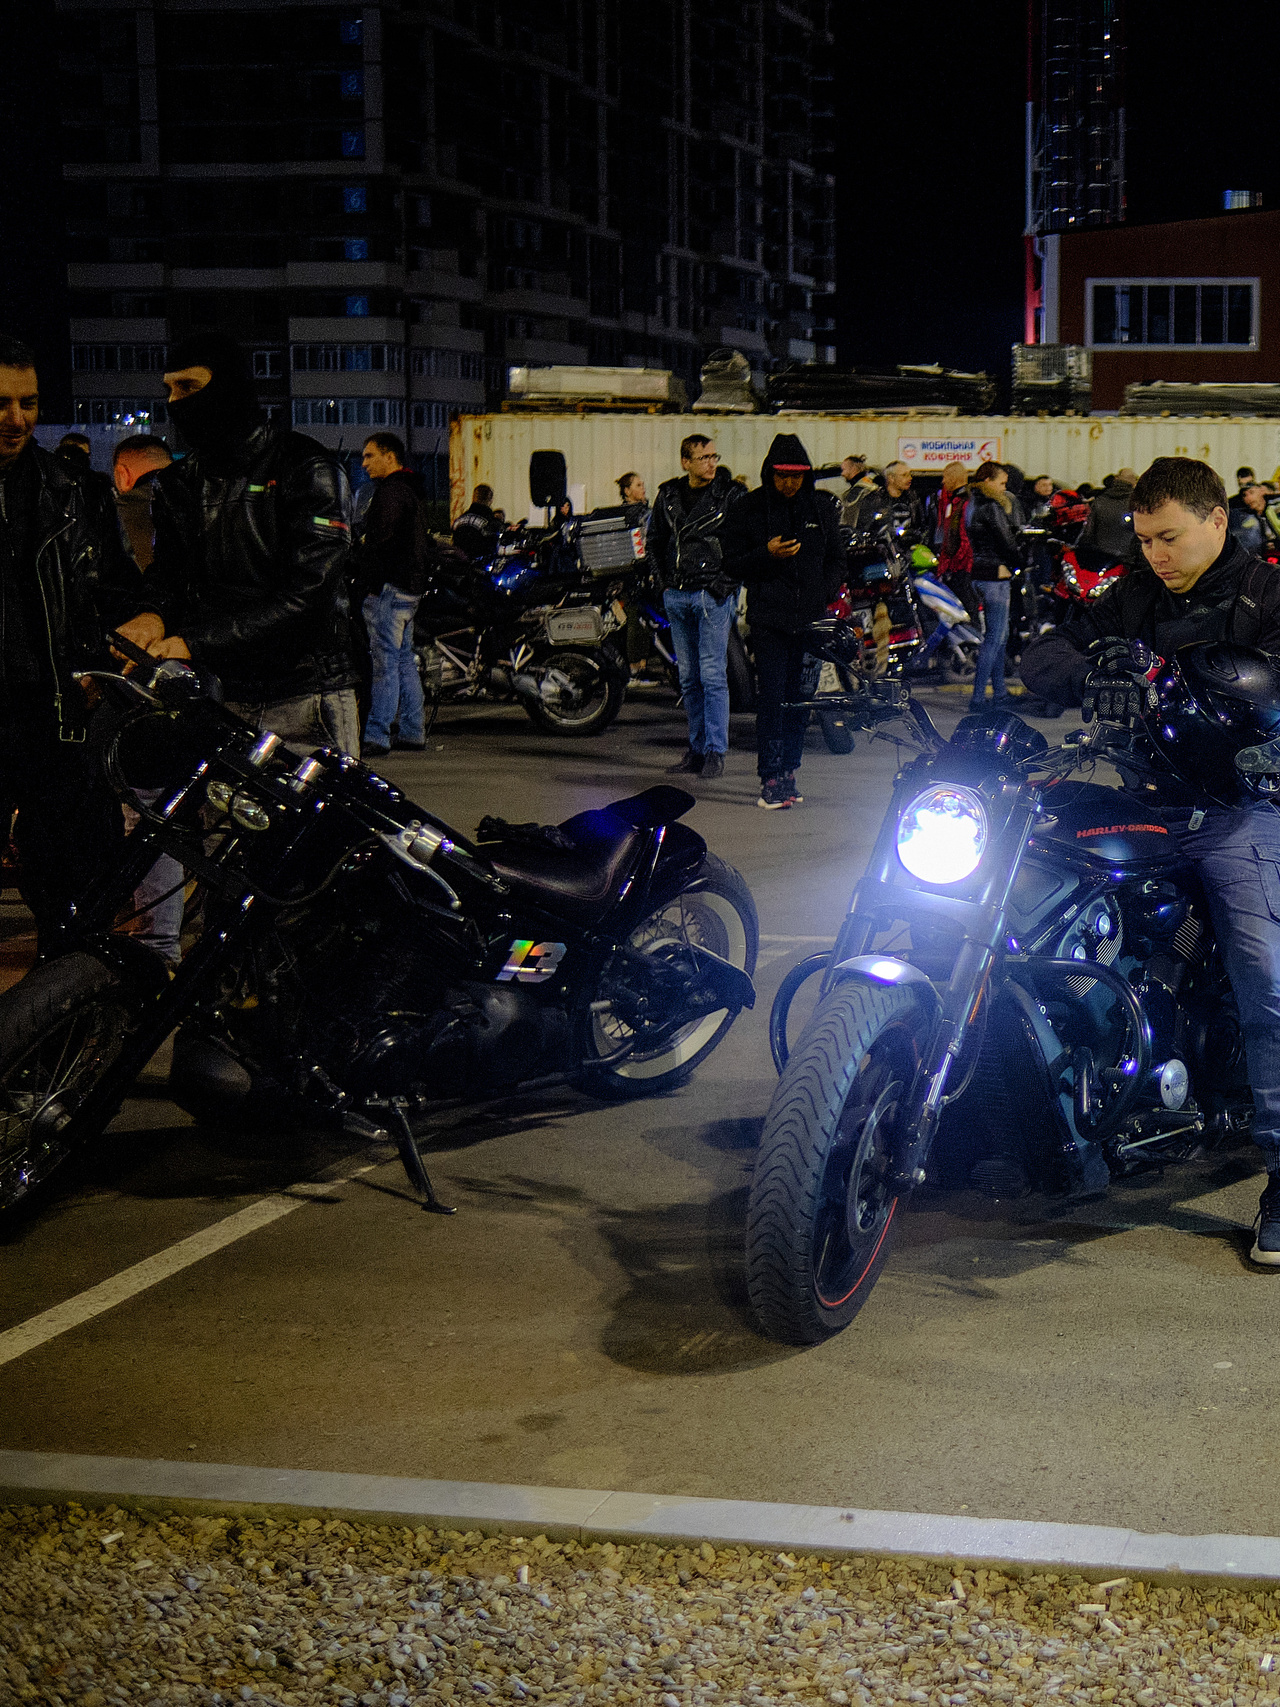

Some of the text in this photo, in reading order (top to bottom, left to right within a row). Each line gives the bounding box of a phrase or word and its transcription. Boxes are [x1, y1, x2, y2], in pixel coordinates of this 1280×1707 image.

[348, 135, 358, 151] 7
[350, 191, 360, 208] 6
[353, 299, 363, 314] 4
[921, 441, 975, 450] МОБИЛЬНАЯ
[1076, 824, 1168, 838] HARLEY-DAVIDSON
[494, 939, 568, 983] 13
